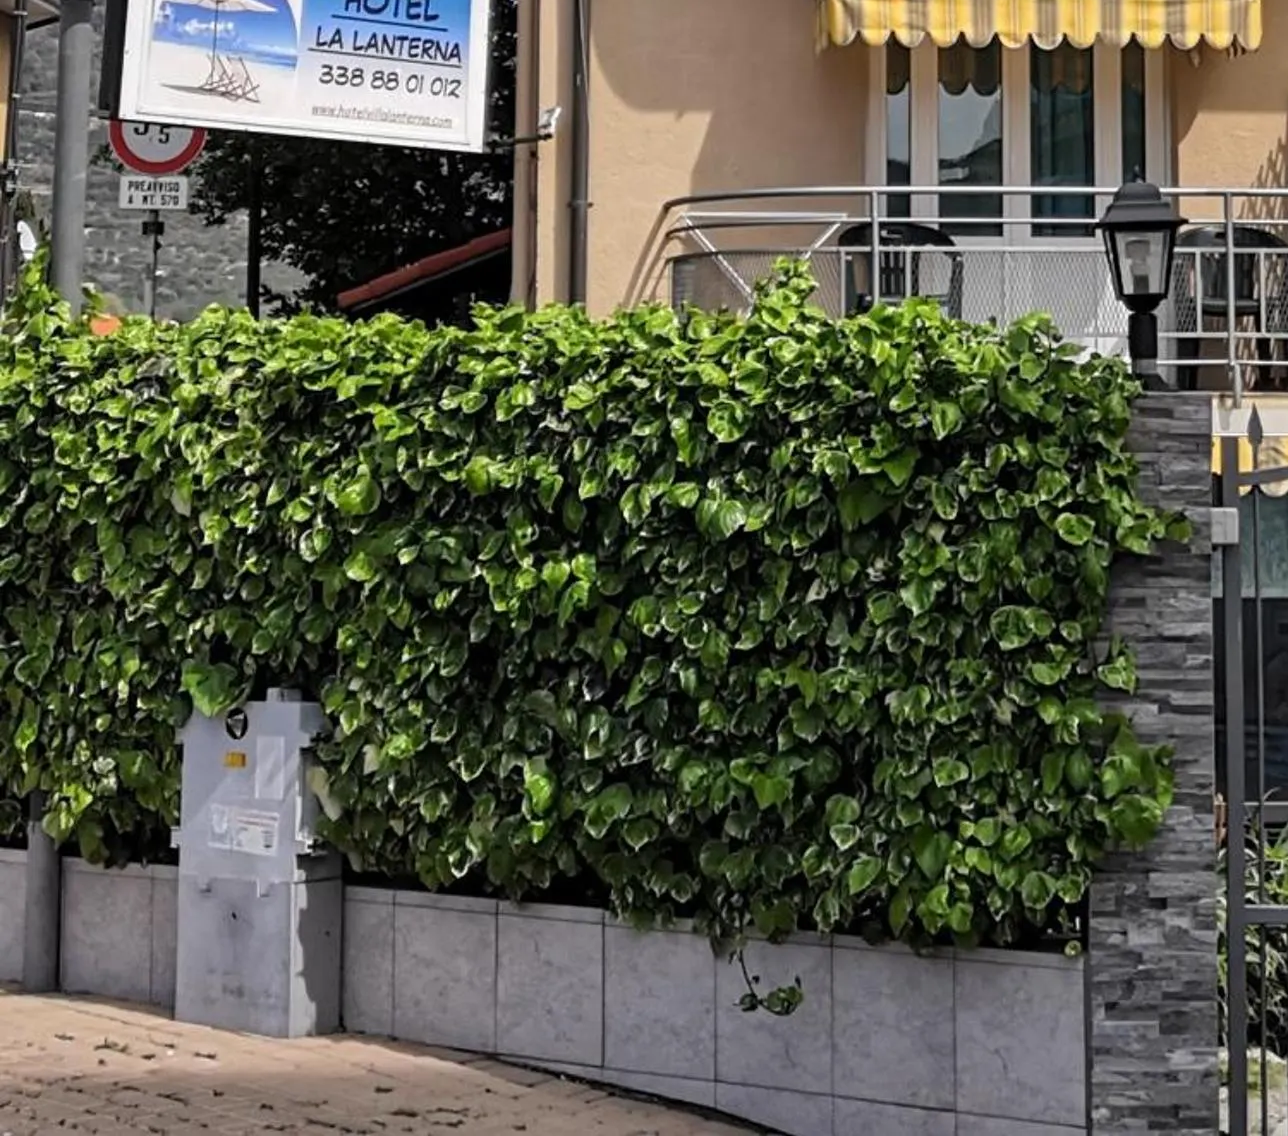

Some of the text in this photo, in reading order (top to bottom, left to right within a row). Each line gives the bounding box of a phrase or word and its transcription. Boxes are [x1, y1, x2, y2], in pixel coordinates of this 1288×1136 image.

[315, 25, 462, 63] LA LANTERNA
[319, 64, 462, 98] 338 88 01 012
